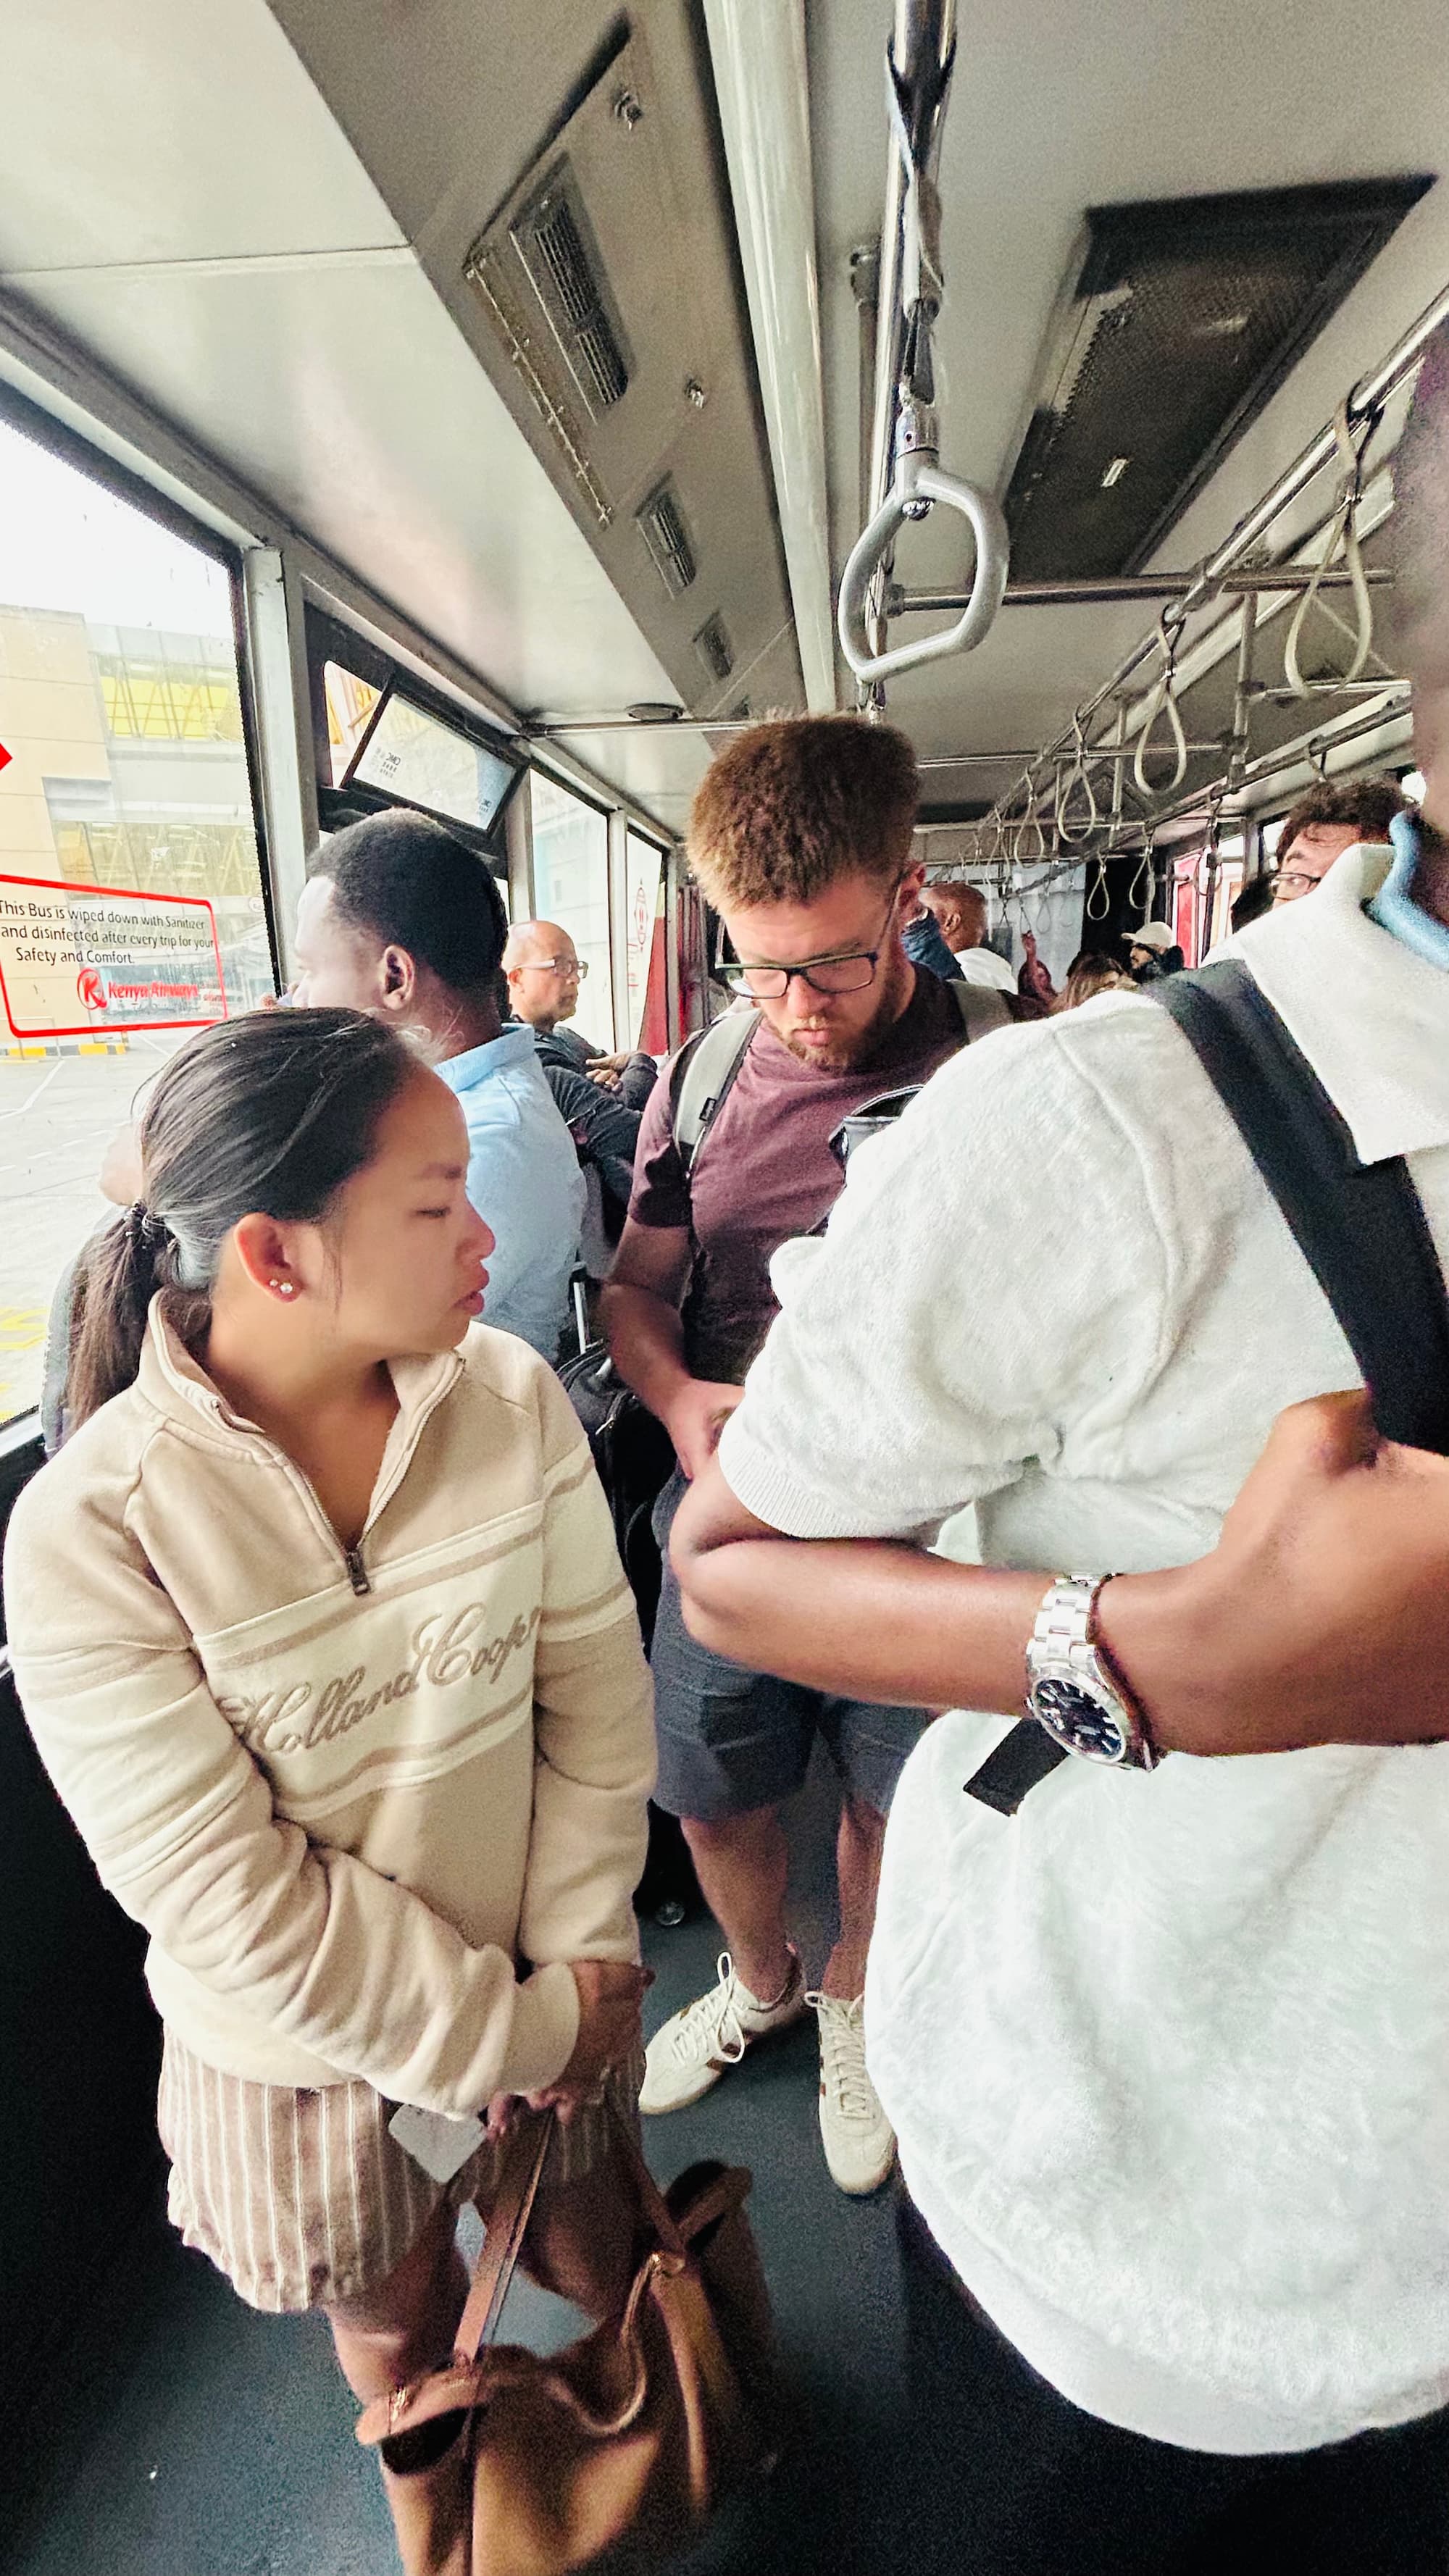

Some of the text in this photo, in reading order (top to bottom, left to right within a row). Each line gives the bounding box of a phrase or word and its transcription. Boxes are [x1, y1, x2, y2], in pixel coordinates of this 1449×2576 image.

[0, 900, 205, 930] This Bus is wiped down with Sanitizer
[1, 925, 214, 951] and disinfected after every trip for your
[15, 947, 57, 966] Safety
[60, 950, 83, 963] and
[109, 981, 199, 1001] Kenya Airways
